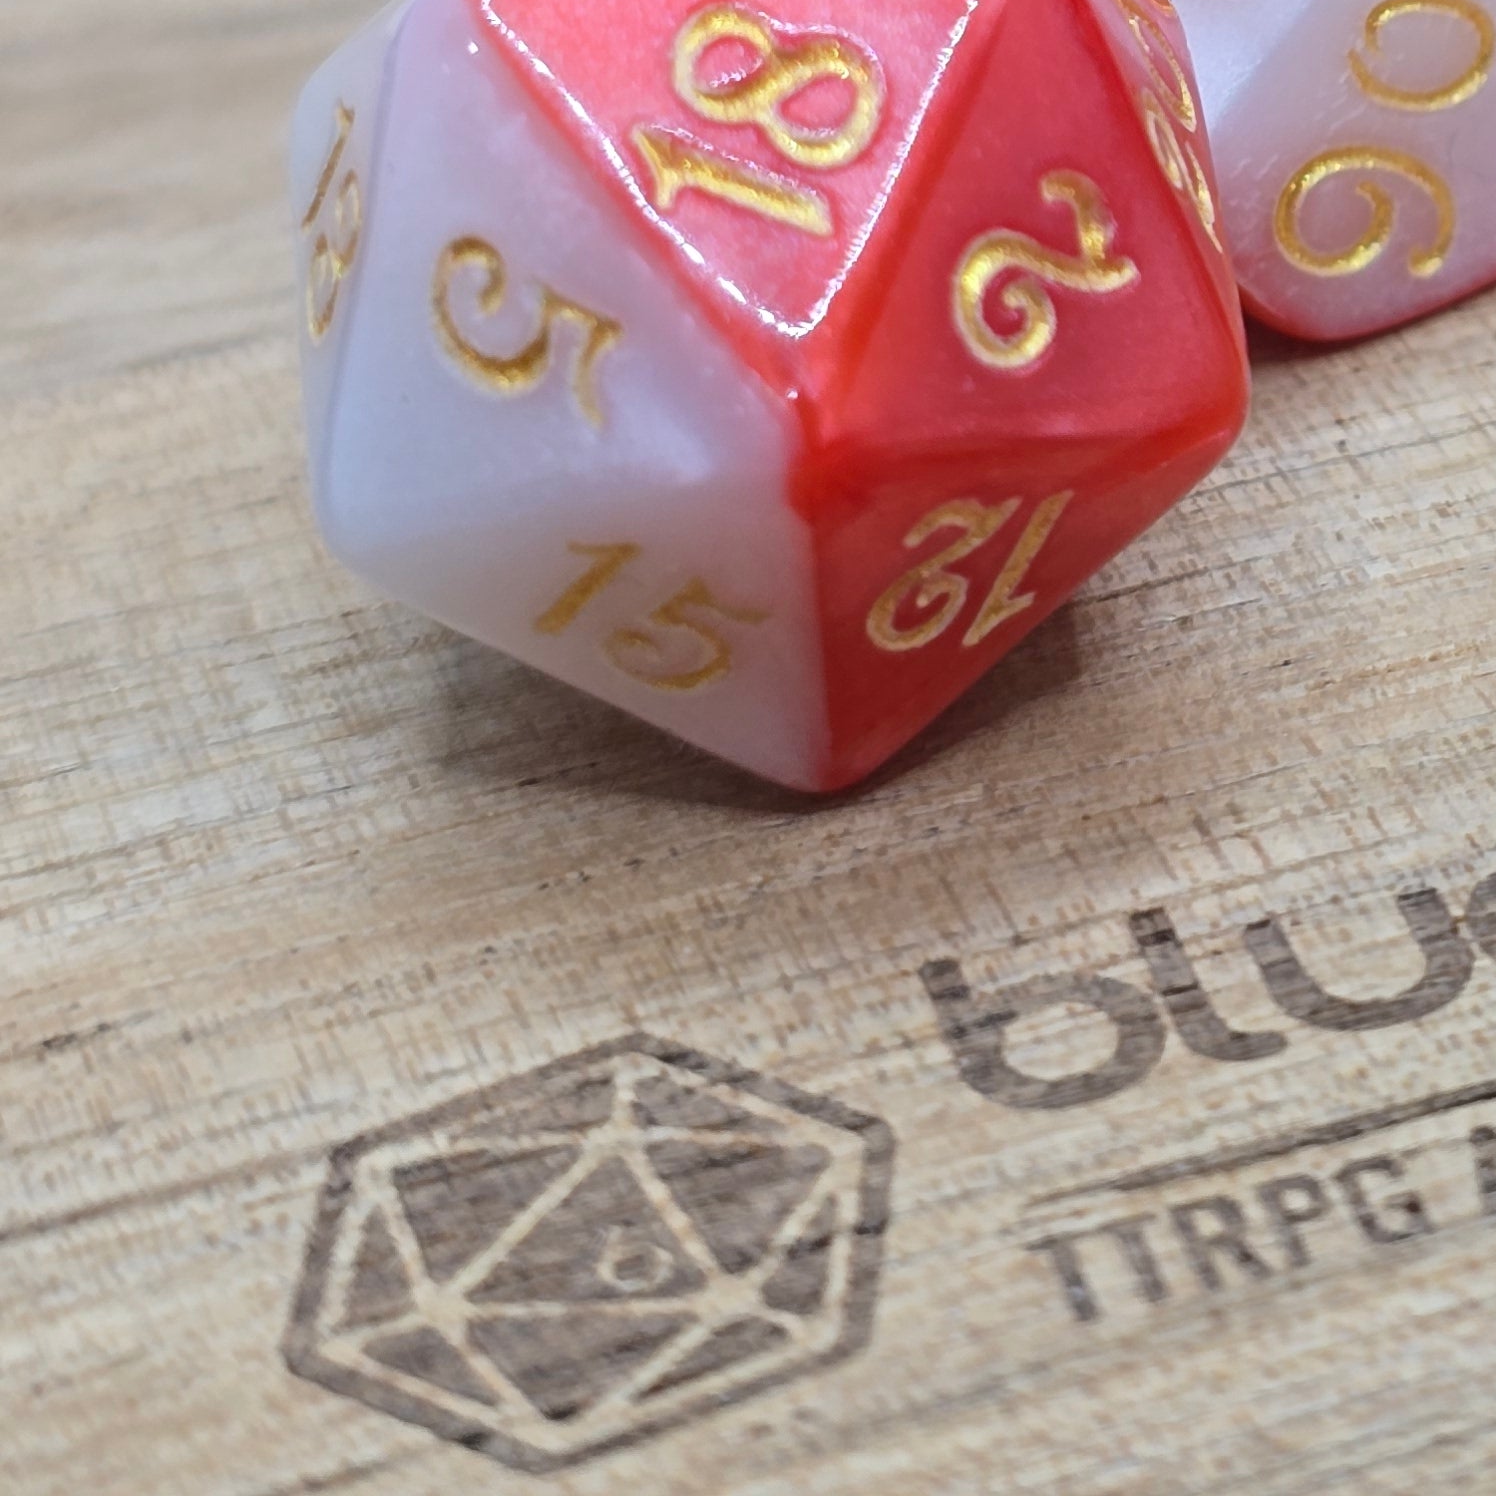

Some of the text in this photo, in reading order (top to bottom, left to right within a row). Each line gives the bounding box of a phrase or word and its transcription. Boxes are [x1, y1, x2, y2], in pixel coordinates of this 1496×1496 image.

[628, 2, 892, 242] 18
[428, 232, 624, 434] 5
[948, 168, 1142, 372] 2
[530, 540, 776, 692] 15
[862, 488, 1076, 654] 12
[1022, 1154, 1436, 1324] TTRPG
